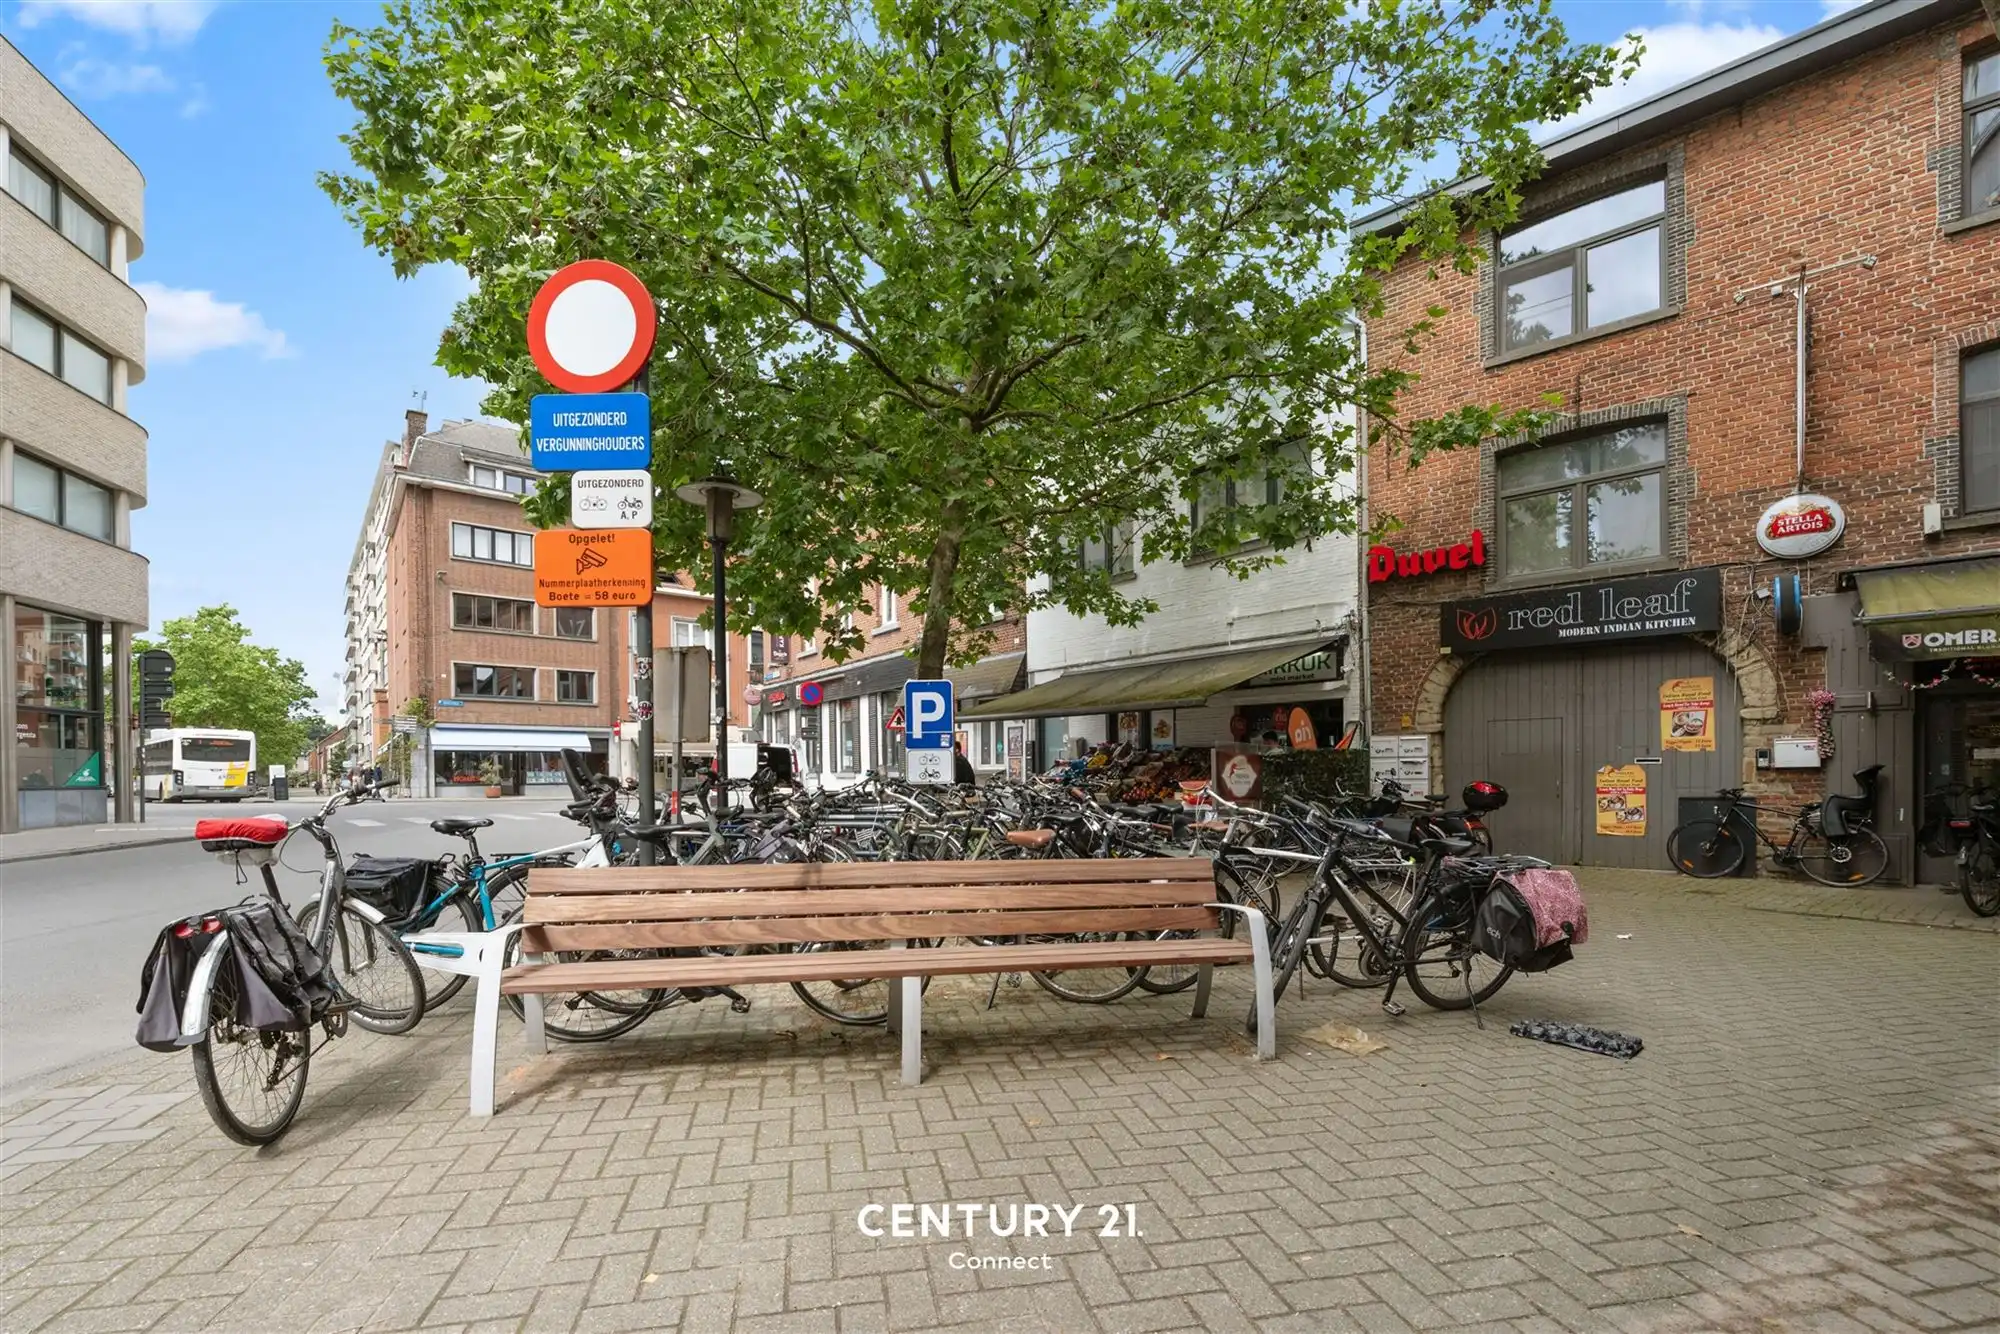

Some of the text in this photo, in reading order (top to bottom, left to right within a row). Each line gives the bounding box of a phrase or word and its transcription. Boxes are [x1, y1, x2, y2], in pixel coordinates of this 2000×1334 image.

[552, 411, 628, 427] UITGEZONDERD
[536, 436, 645, 452] VERGUNNINGHOUDERS
[577, 478, 644, 489] UITGEZONDERD
[632, 511, 638, 519] P
[1777, 513, 1823, 527] STELLA
[1777, 520, 1824, 535] ARTOIS
[568, 533, 615, 546] Opgelet!
[1366, 528, 1486, 583] Duvel
[539, 579, 646, 589] Nummerplaatherkenning
[549, 591, 580, 601] Boete
[595, 591, 609, 600] 58
[612, 591, 636, 600] euro
[1508, 577, 1698, 630] red leaf
[1558, 616, 1697, 638] MODERN INDIAN KITCHEN
[911, 691, 946, 739] P
